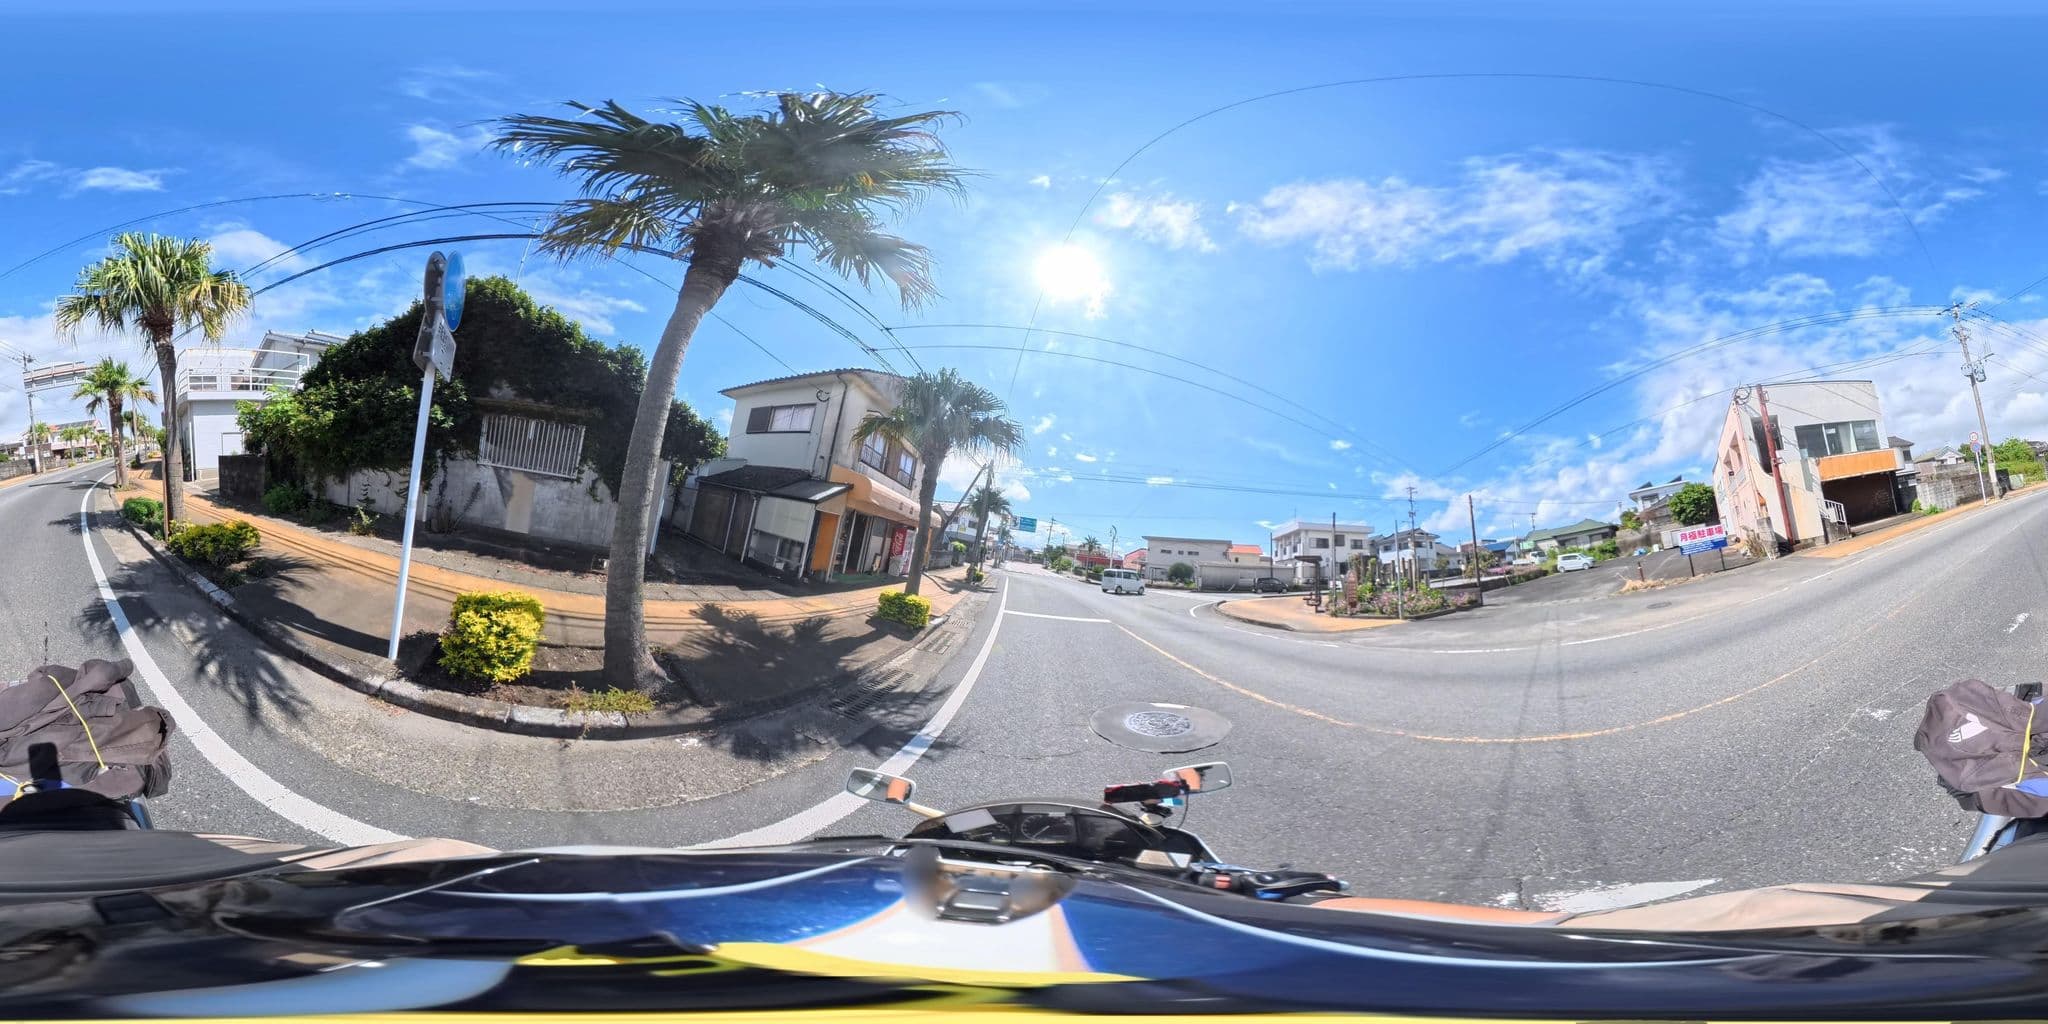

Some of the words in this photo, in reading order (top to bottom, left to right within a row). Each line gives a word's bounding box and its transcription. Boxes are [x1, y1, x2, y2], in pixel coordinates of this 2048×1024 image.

[1680, 525, 1724, 542] 月極駐車場
